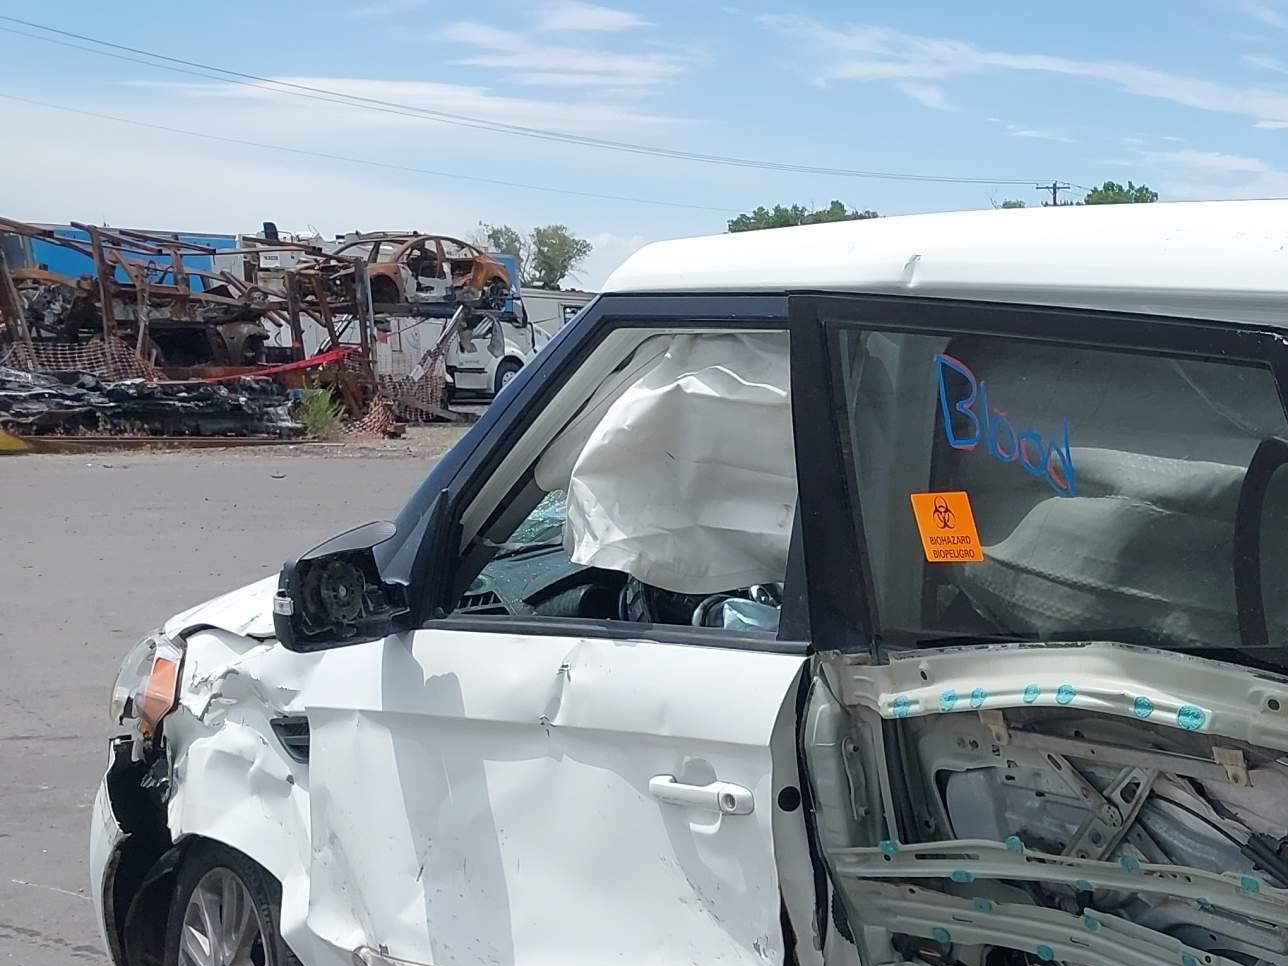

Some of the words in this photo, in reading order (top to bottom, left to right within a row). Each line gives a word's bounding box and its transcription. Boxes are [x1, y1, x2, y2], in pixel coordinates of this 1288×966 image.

[933, 353, 1077, 499] Blood
[929, 535, 972, 546] BIOHAZARD
[932, 548, 976, 559] BIOPELIGRO
